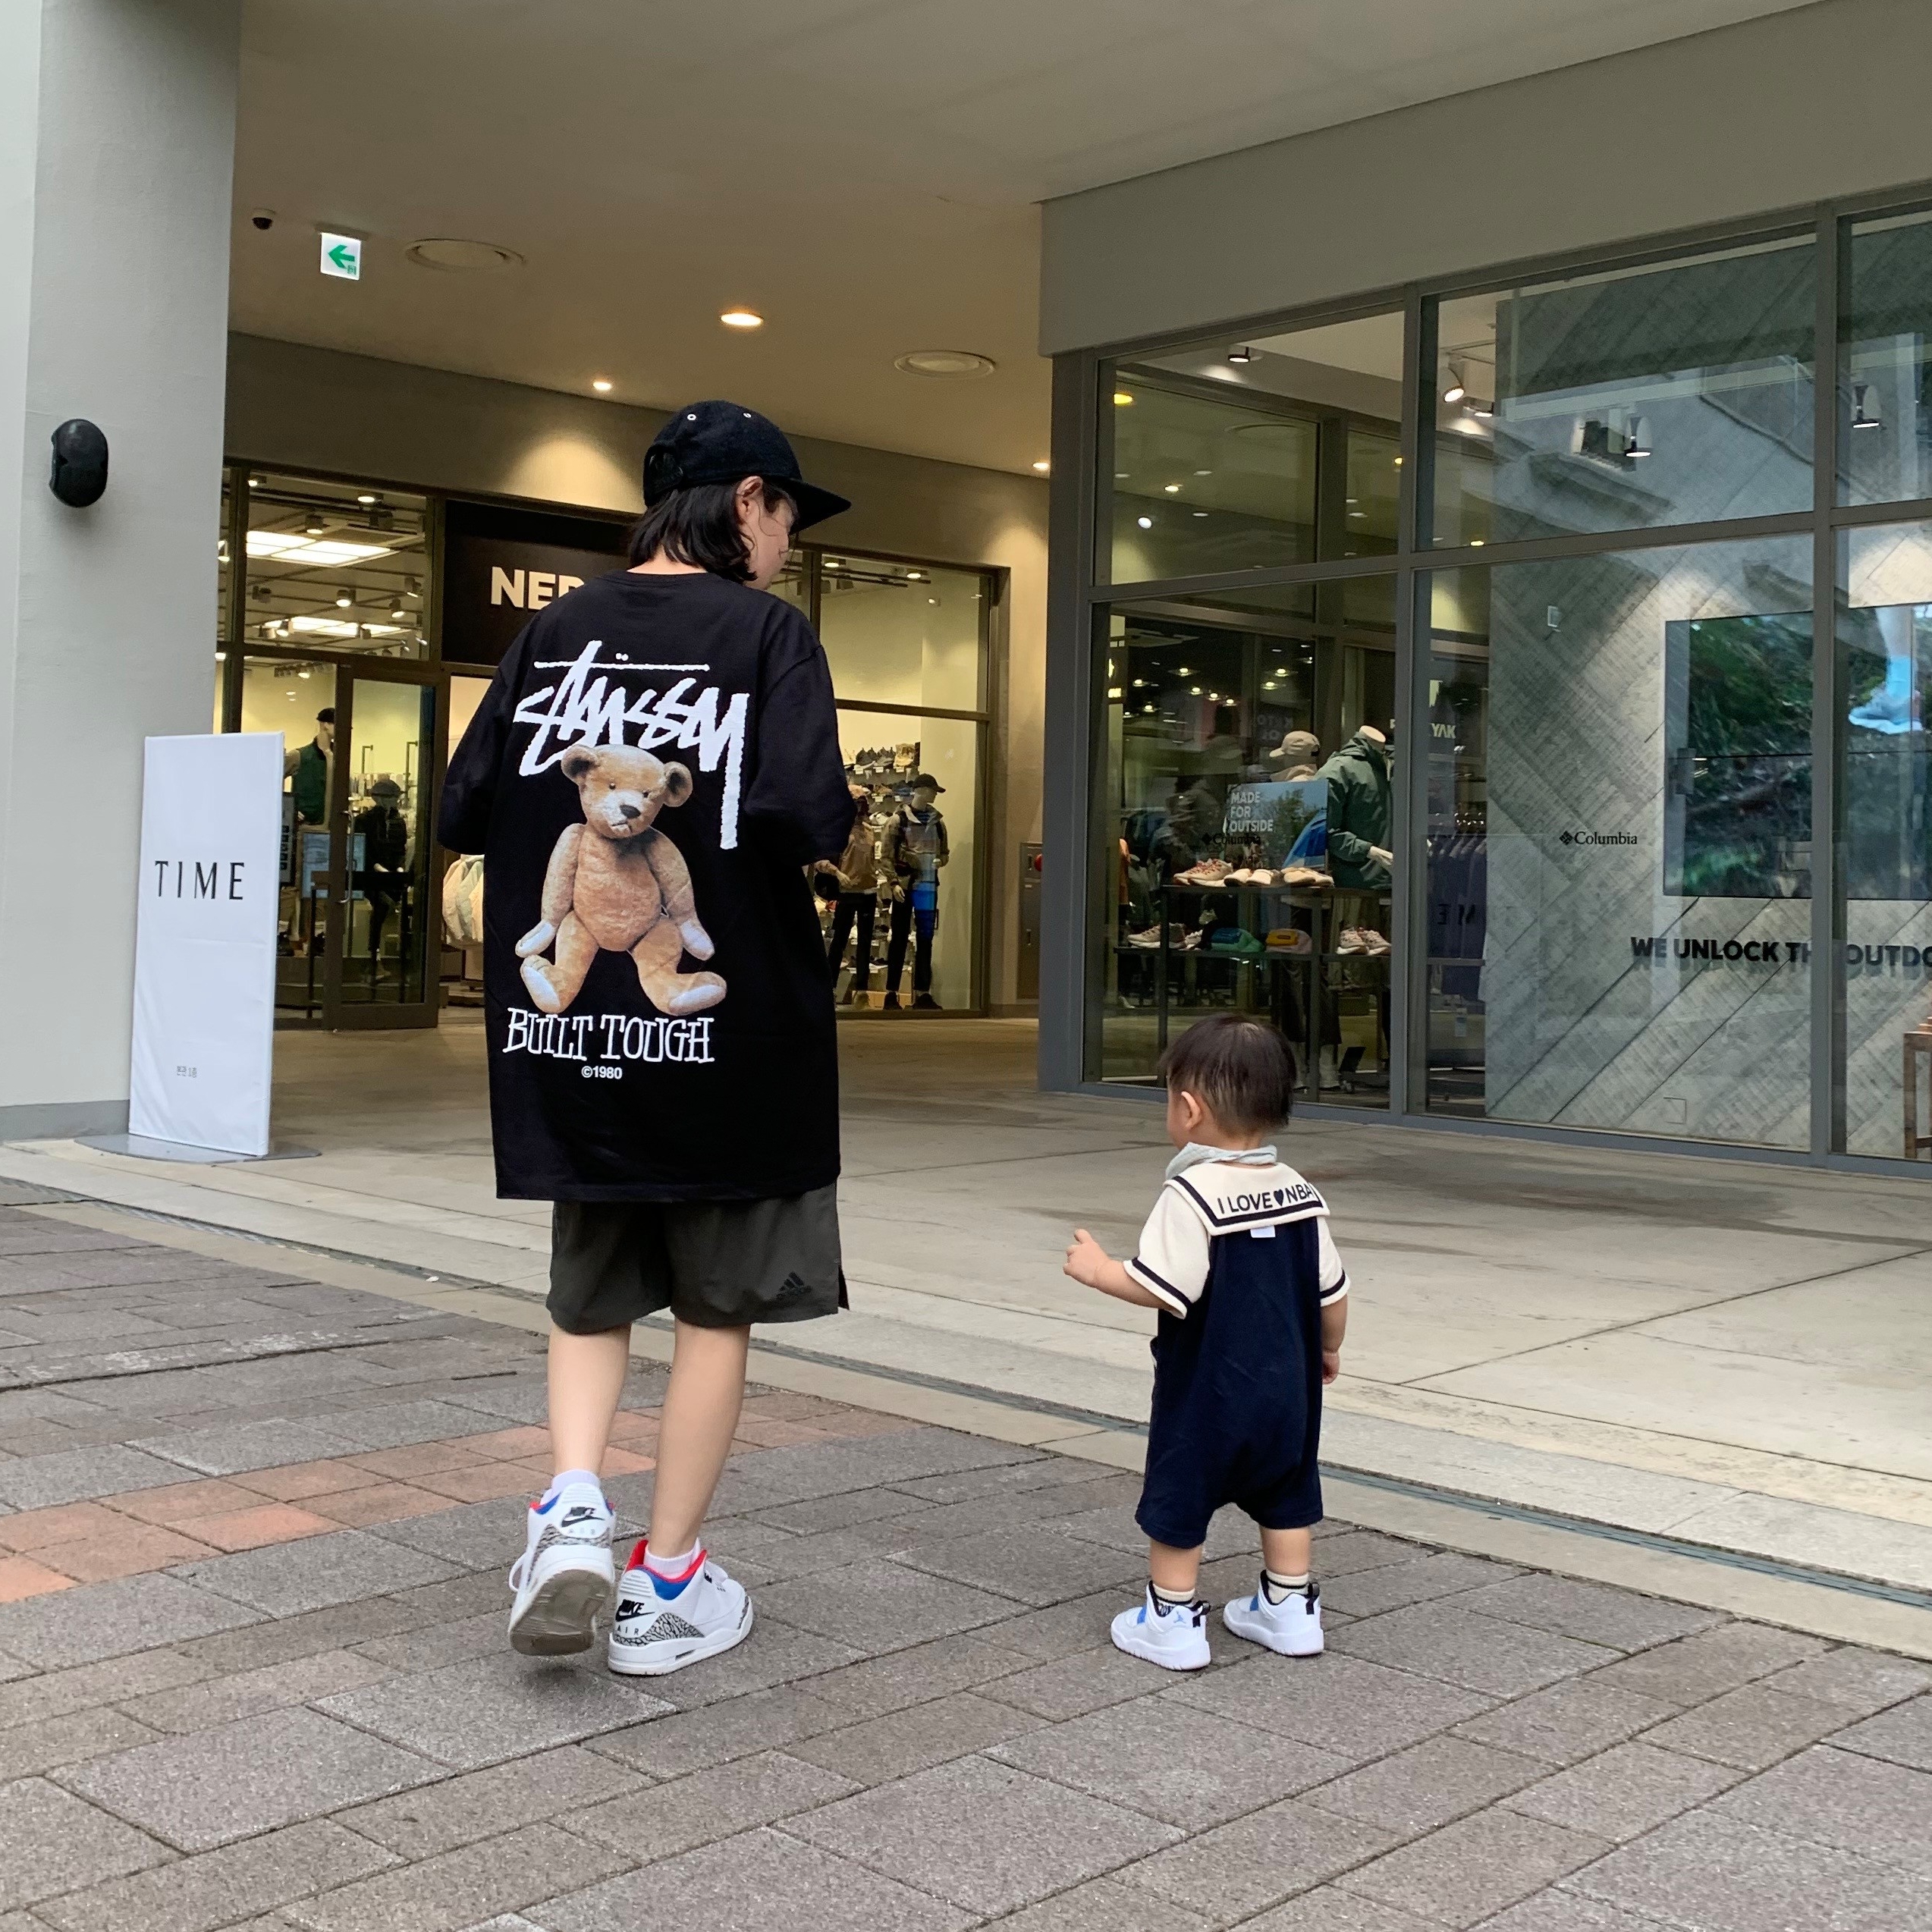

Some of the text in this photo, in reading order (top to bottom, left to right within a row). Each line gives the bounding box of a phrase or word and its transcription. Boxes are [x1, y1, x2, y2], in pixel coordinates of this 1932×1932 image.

[1230, 791, 1261, 804] MADE
[1230, 806, 1252, 818] FOR
[1229, 819, 1274, 832] OUTSIDE
[1574, 831, 1638, 845] Columbia
[155, 861, 245, 900] TIME
[1631, 937, 1667, 958] WE
[1673, 938, 1779, 963] UNLOCK
[502, 1007, 715, 1063] BUILT TOUGH
[1217, 1198, 1224, 1214] I
[1227, 1192, 1273, 1212] LOVE
